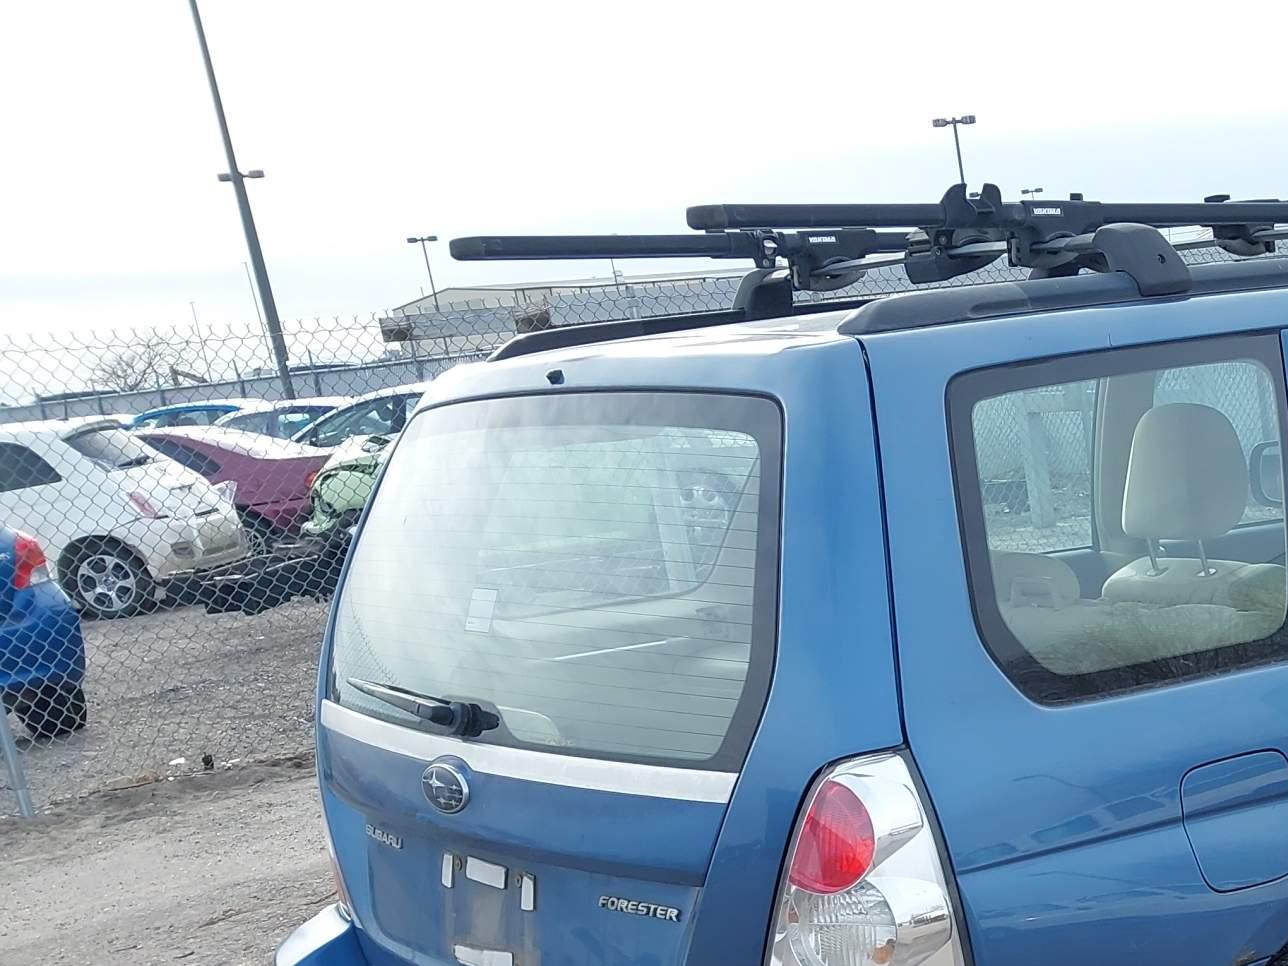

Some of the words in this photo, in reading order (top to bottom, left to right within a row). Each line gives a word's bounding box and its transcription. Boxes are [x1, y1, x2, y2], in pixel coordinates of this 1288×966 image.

[1033, 207, 1061, 215] YAKIMA
[366, 823, 403, 849] SUBARU
[598, 895, 681, 922] FORESTER
